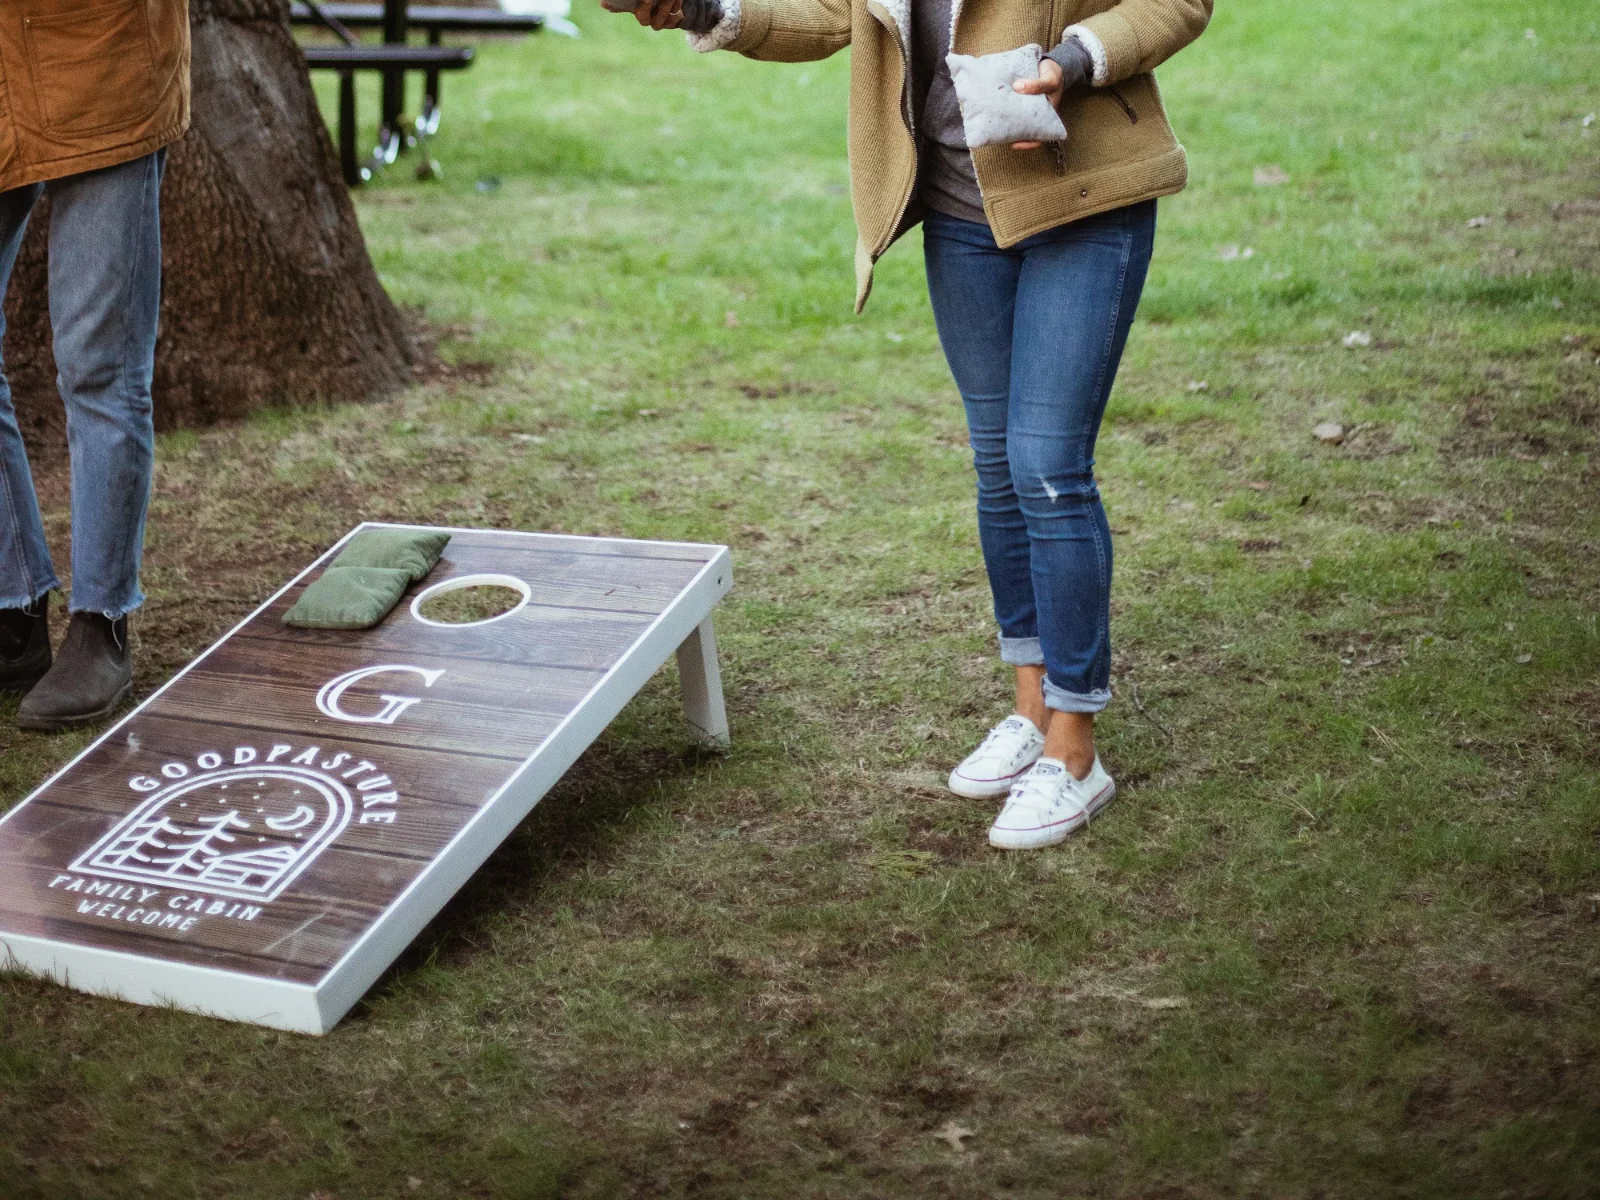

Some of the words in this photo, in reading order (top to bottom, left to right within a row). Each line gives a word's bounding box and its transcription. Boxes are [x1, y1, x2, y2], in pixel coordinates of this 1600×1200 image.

[315, 664, 446, 724] G
[128, 744, 398, 825] GOODPASTURE
[48, 875, 159, 903] FAMILY
[168, 895, 263, 921] CABIN
[76, 899, 198, 931] WELCOME
